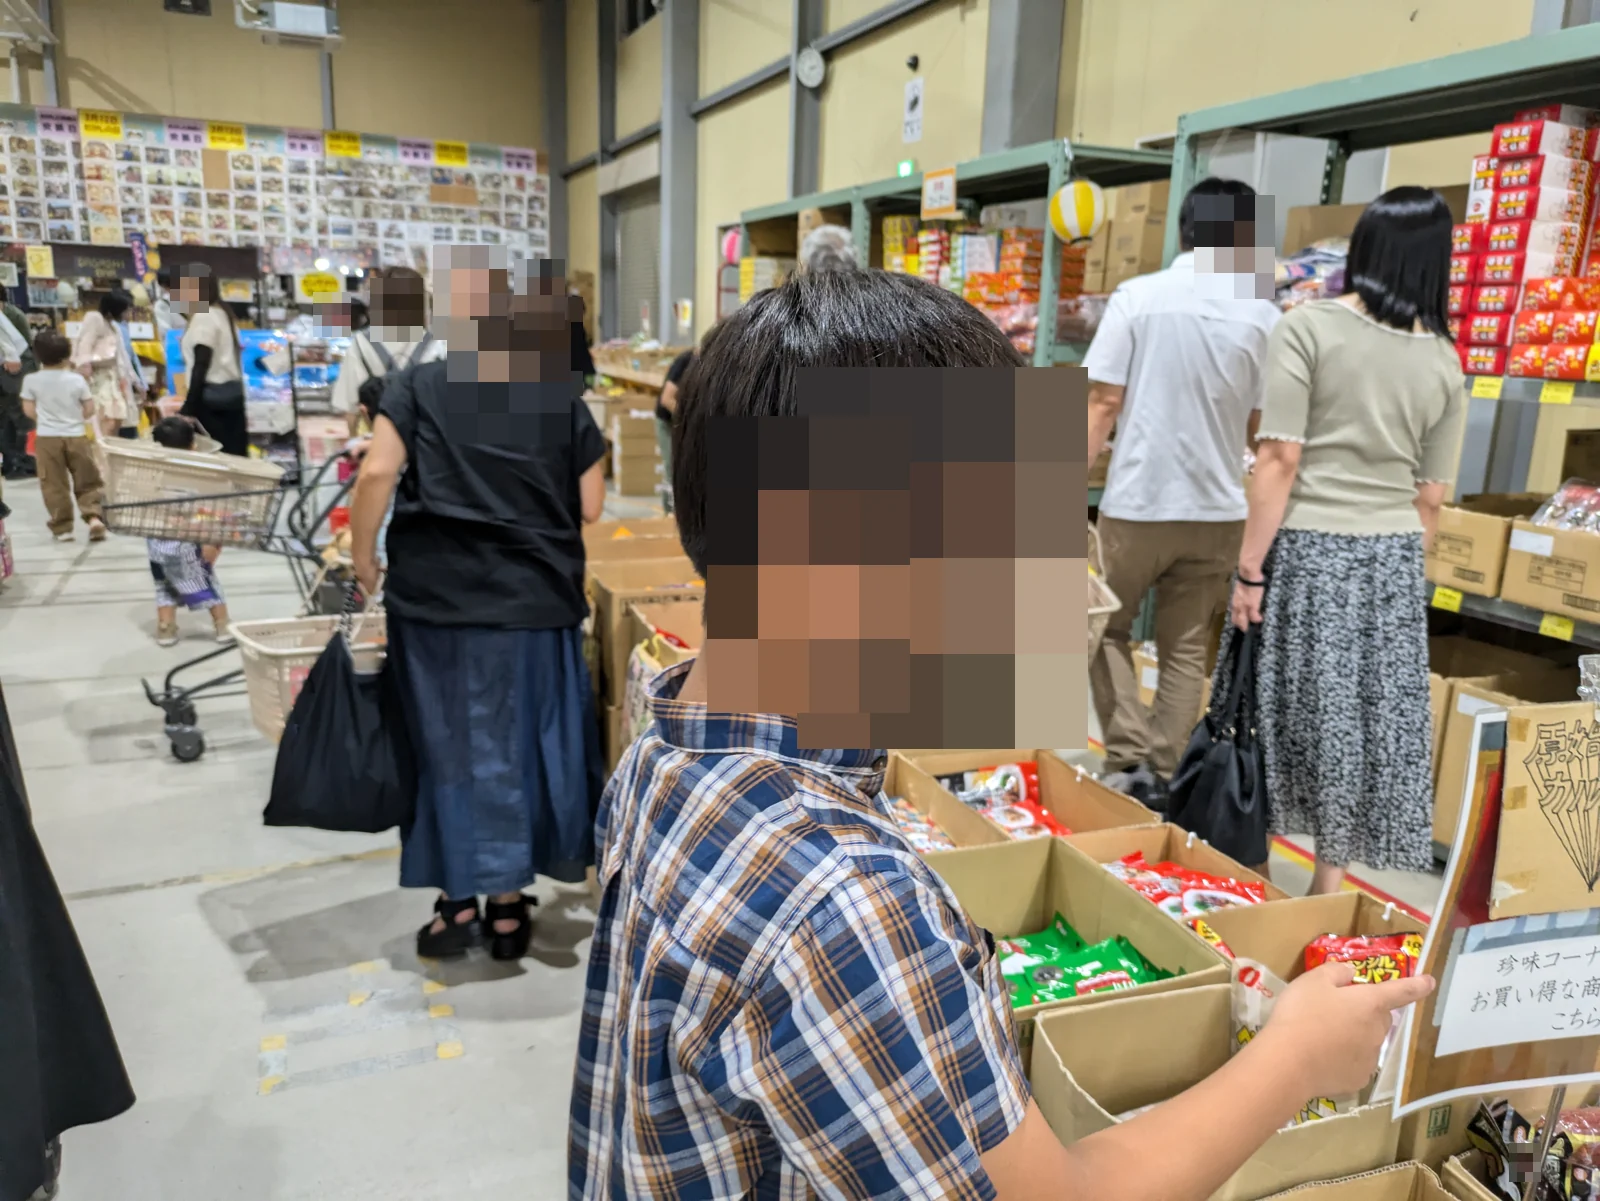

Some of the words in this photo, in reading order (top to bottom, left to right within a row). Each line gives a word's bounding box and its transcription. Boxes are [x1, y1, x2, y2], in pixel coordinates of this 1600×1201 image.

[1497, 945, 1600, 977] 珍味コーナ
[1470, 975, 1600, 1013] お買い得な商
[1551, 1007, 1600, 1031] こちら
